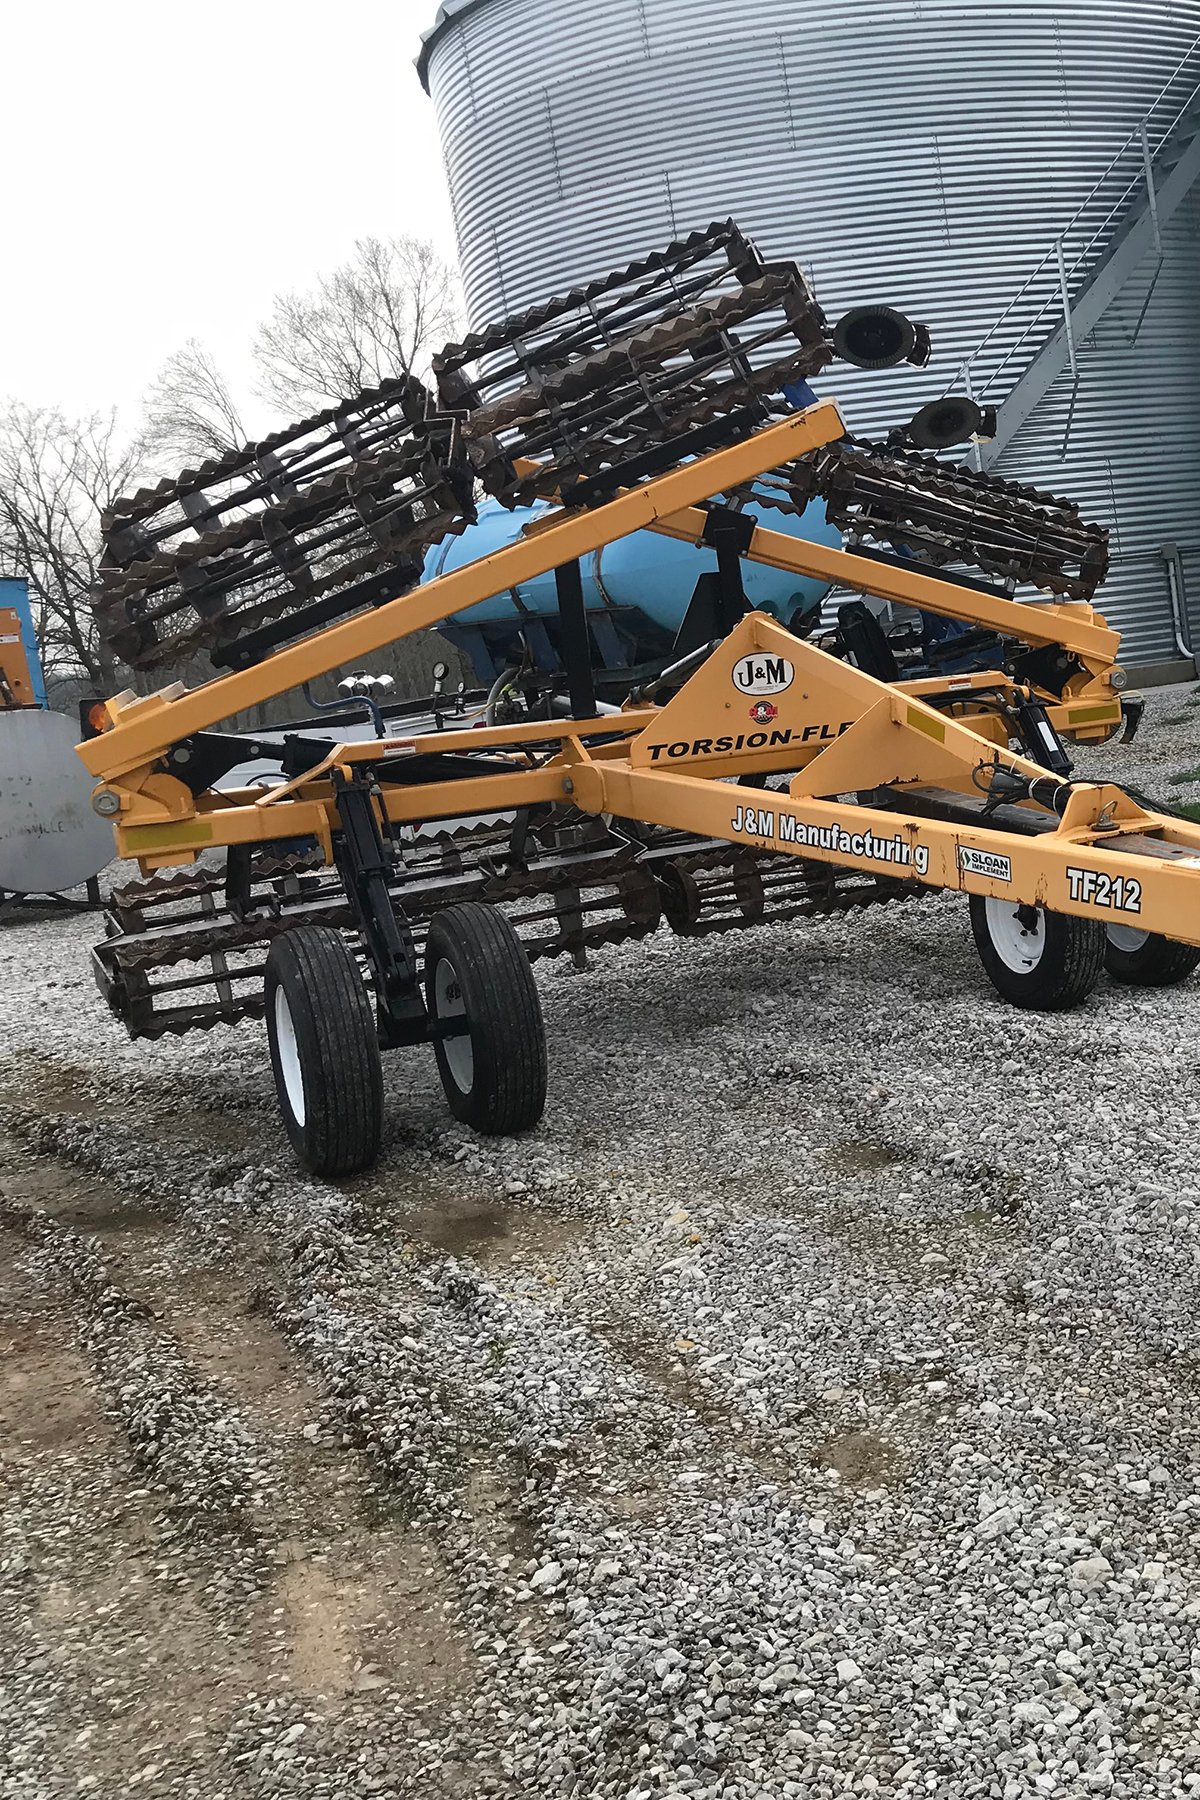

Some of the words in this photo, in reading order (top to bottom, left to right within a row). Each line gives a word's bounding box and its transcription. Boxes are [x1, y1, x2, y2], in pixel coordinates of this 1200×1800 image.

[737, 658, 787, 687] J&M
[732, 806, 774, 837] J&M
[779, 813, 930, 875] Manufacturing
[971, 852, 1009, 871] SLOAN
[971, 863, 1009, 878] IMPLEMENT
[1066, 866, 1142, 914] TF212
